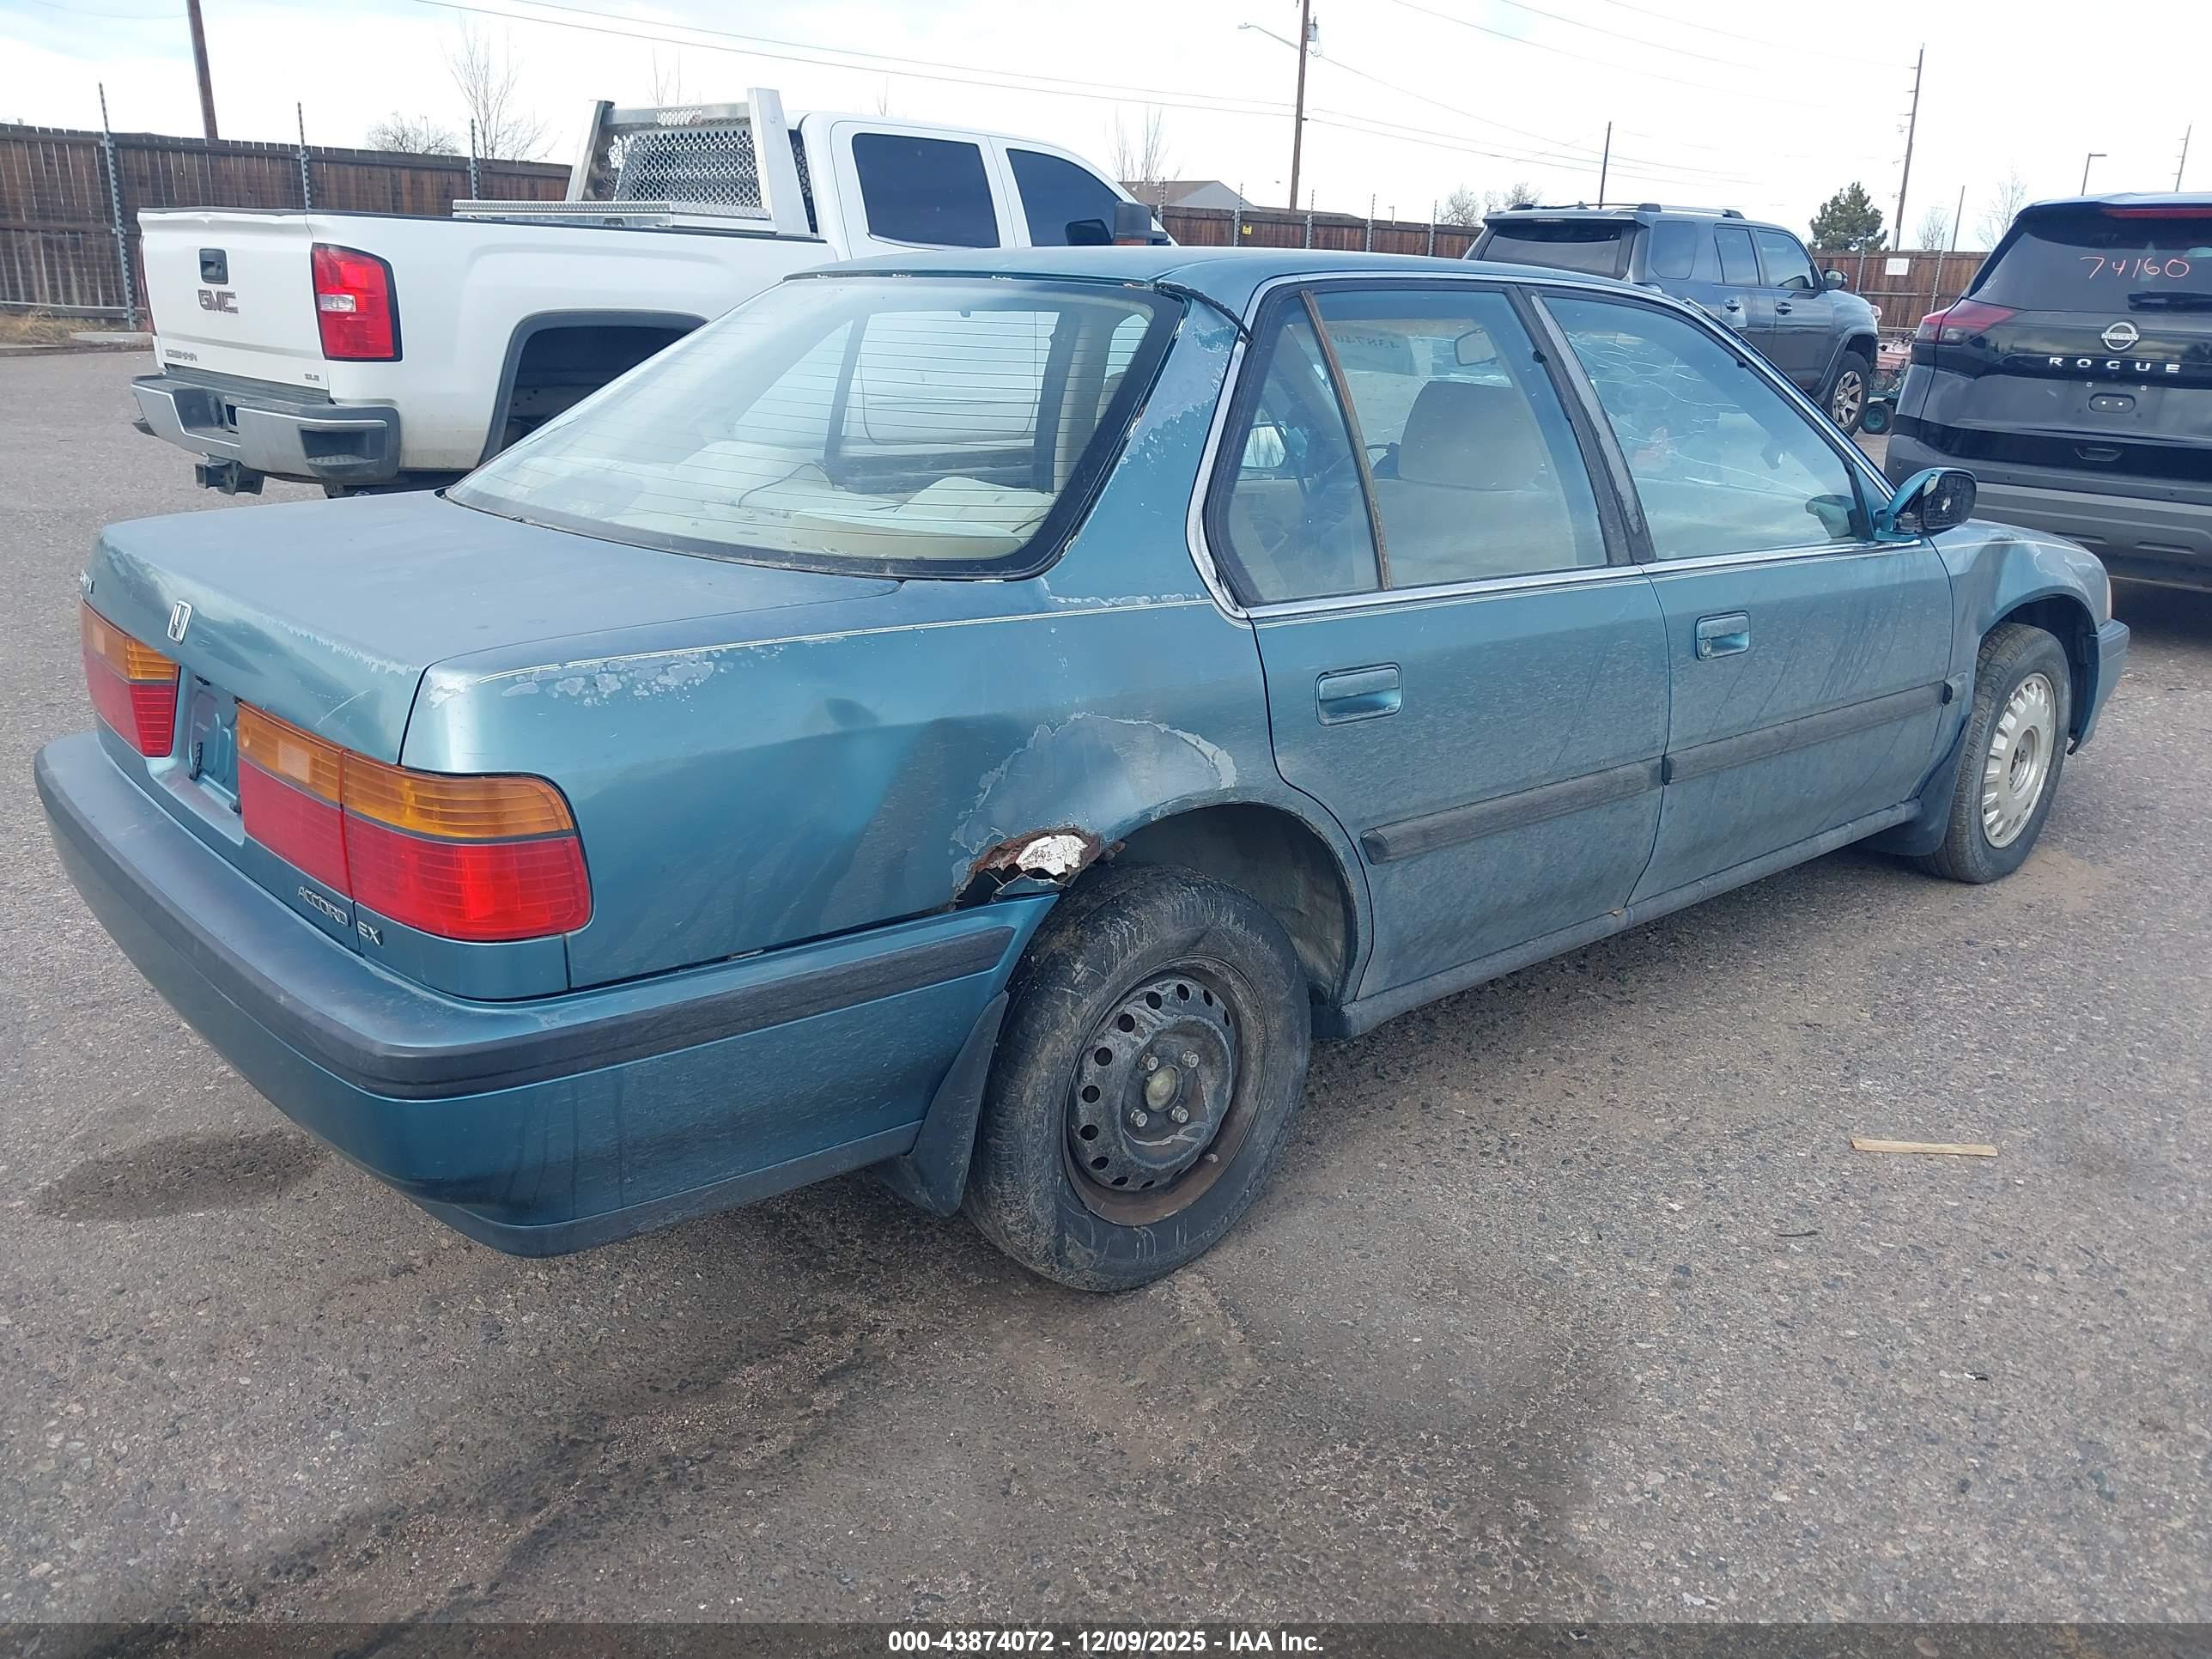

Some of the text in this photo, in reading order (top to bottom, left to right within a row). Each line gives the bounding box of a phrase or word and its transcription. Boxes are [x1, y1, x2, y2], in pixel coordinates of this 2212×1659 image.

[2079, 256, 2190, 279] 74160
[198, 289, 239, 313] GMC
[2049, 356, 2180, 374] ROGUE
[298, 886, 383, 945] ACCORD EX
